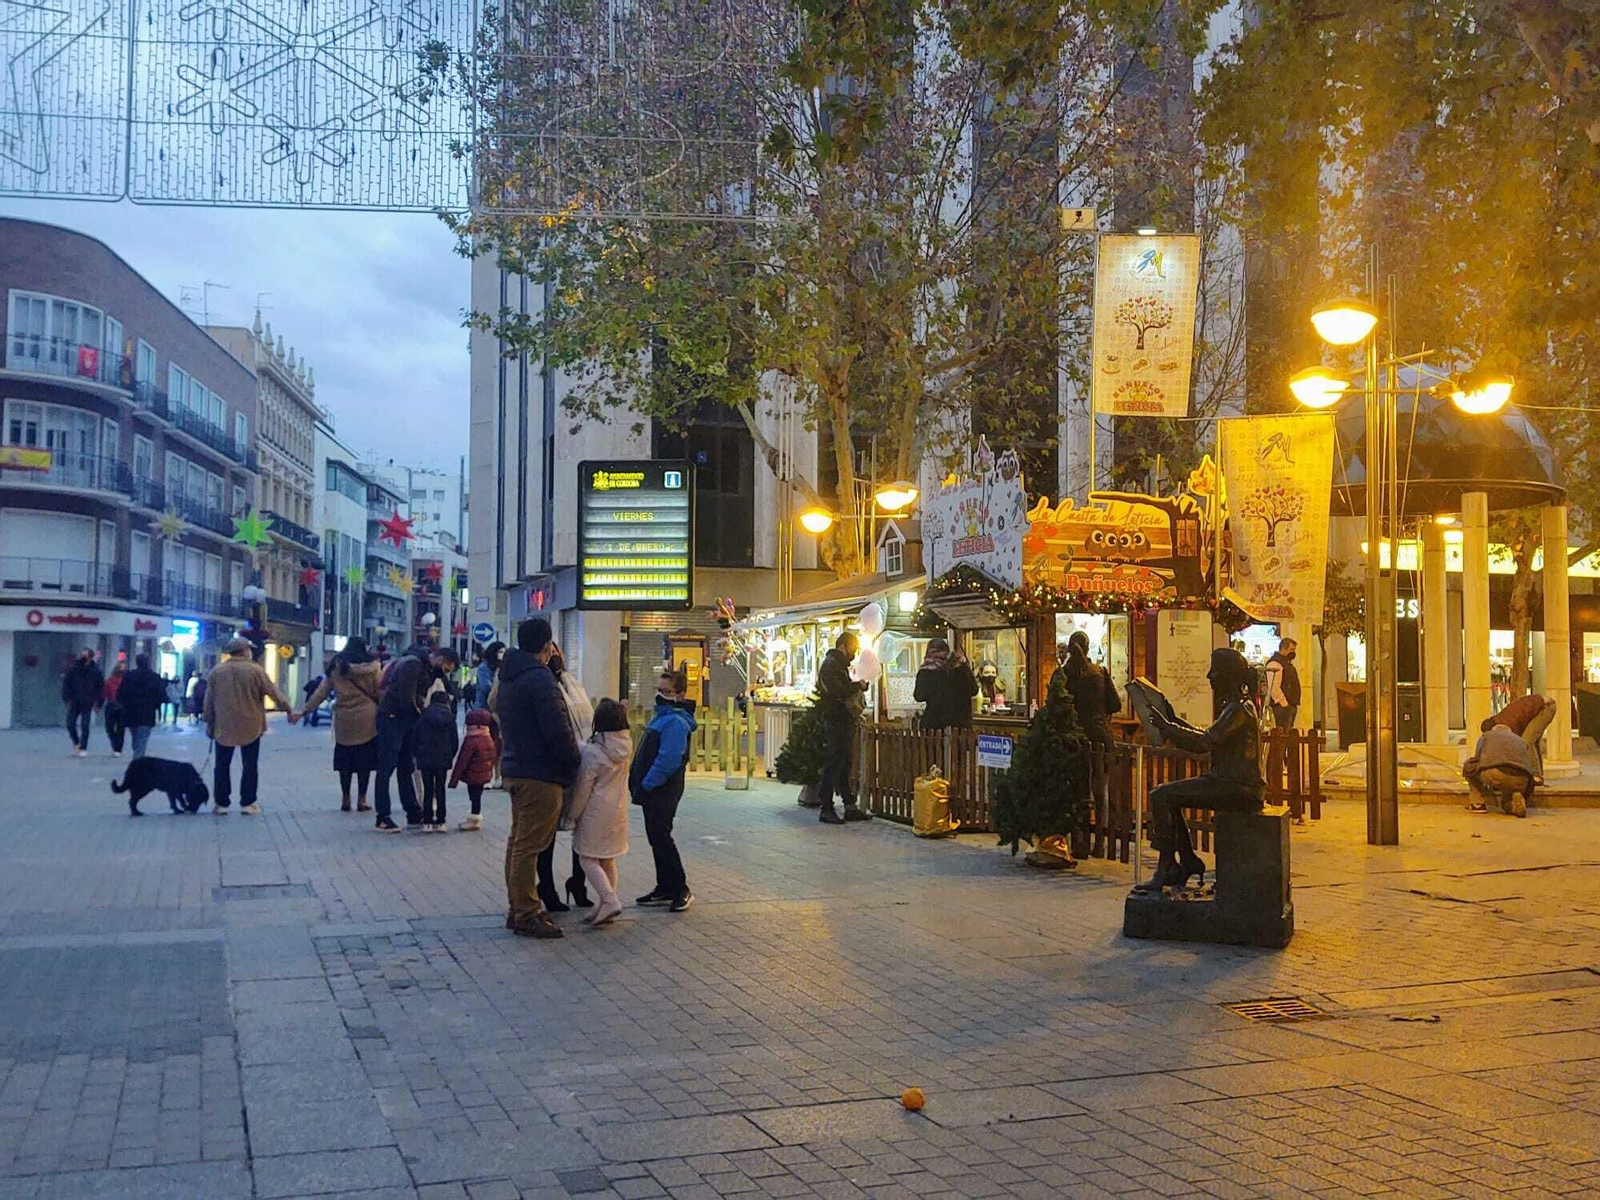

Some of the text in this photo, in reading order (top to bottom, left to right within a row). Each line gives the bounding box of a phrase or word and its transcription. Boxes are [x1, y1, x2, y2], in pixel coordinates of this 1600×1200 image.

[613, 512, 654, 521] VIERNES
[1034, 498, 1050, 521] La
[1055, 501, 1099, 524] Casita
[1101, 502, 1117, 522] de
[1066, 573, 1154, 594] Buñuelos
